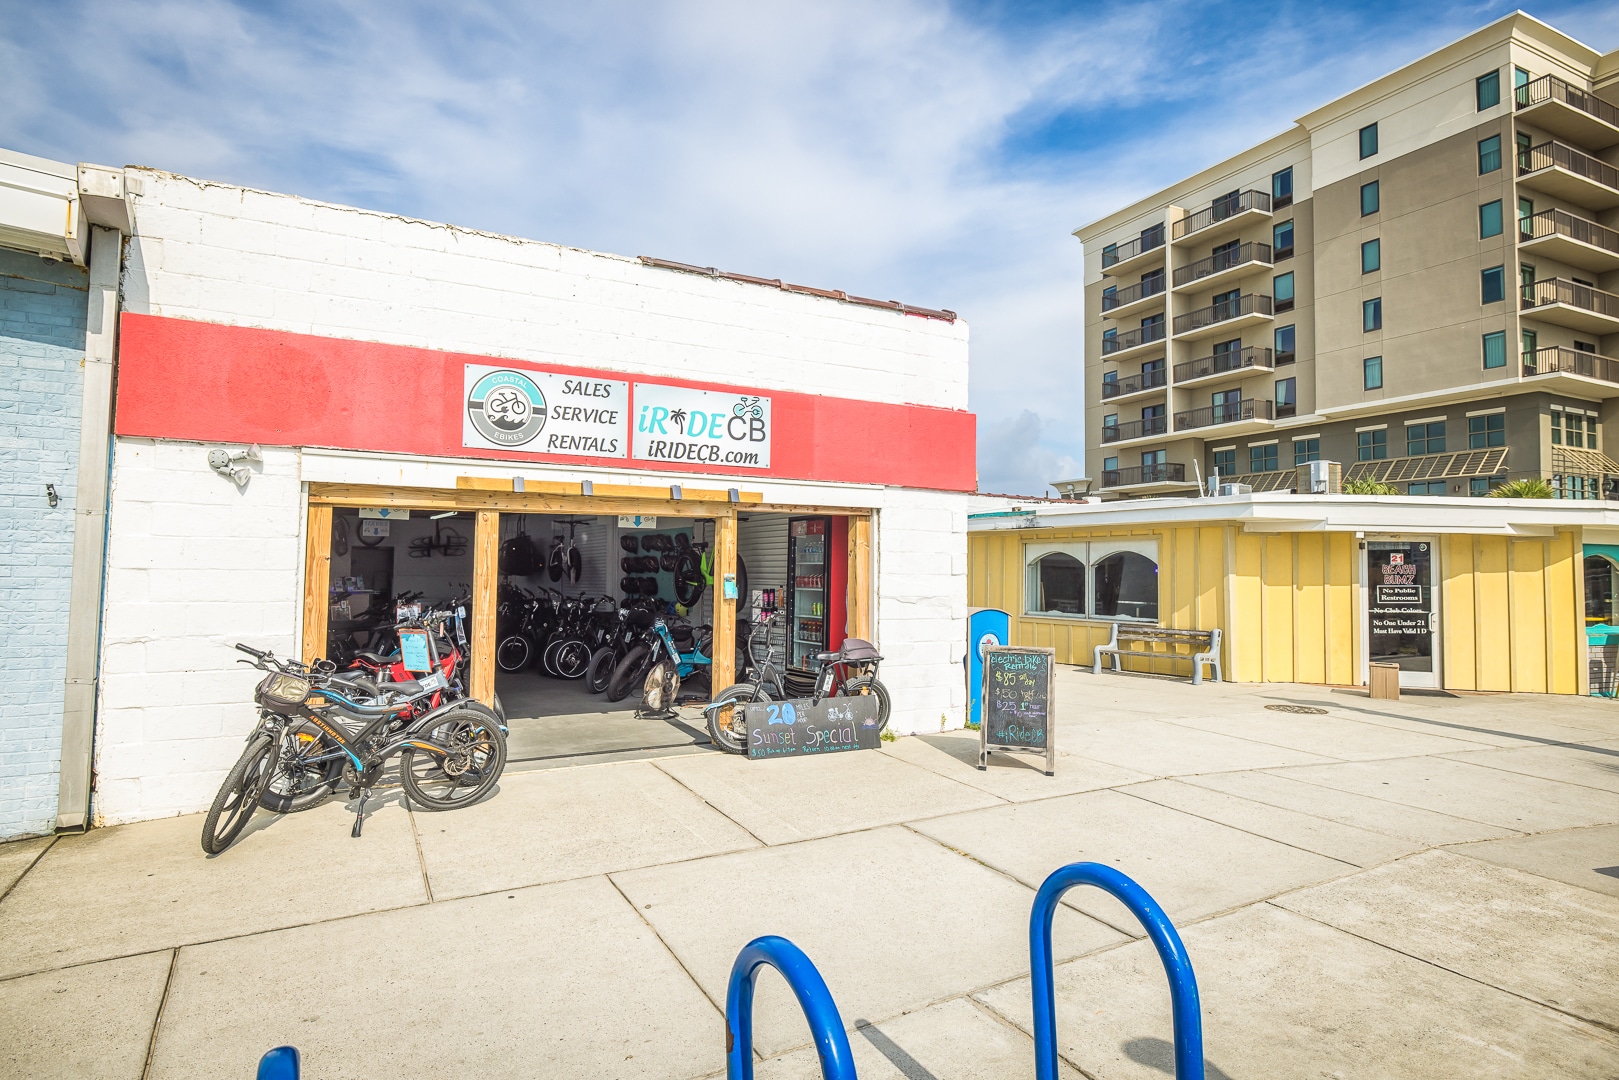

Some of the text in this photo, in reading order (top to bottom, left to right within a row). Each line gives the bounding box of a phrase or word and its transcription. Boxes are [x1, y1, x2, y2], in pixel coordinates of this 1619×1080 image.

[491, 375, 528, 389] COASTAL
[562, 379, 612, 399] SALES
[551, 405, 619, 425] SERVICE
[494, 431, 524, 441] EBIKES
[547, 433, 618, 453] RENTALS
[648, 440, 759, 465] iRIDECB.com
[1391, 555, 1404, 563] 21
[1381, 564, 1417, 575] BEACH
[1383, 574, 1415, 585] BUMZ
[995, 670, 1016, 686] $85
[766, 702, 796, 726] 20
[996, 700, 1017, 711] $25
[752, 727, 797, 746] Sunset
[805, 720, 859, 747] Special
